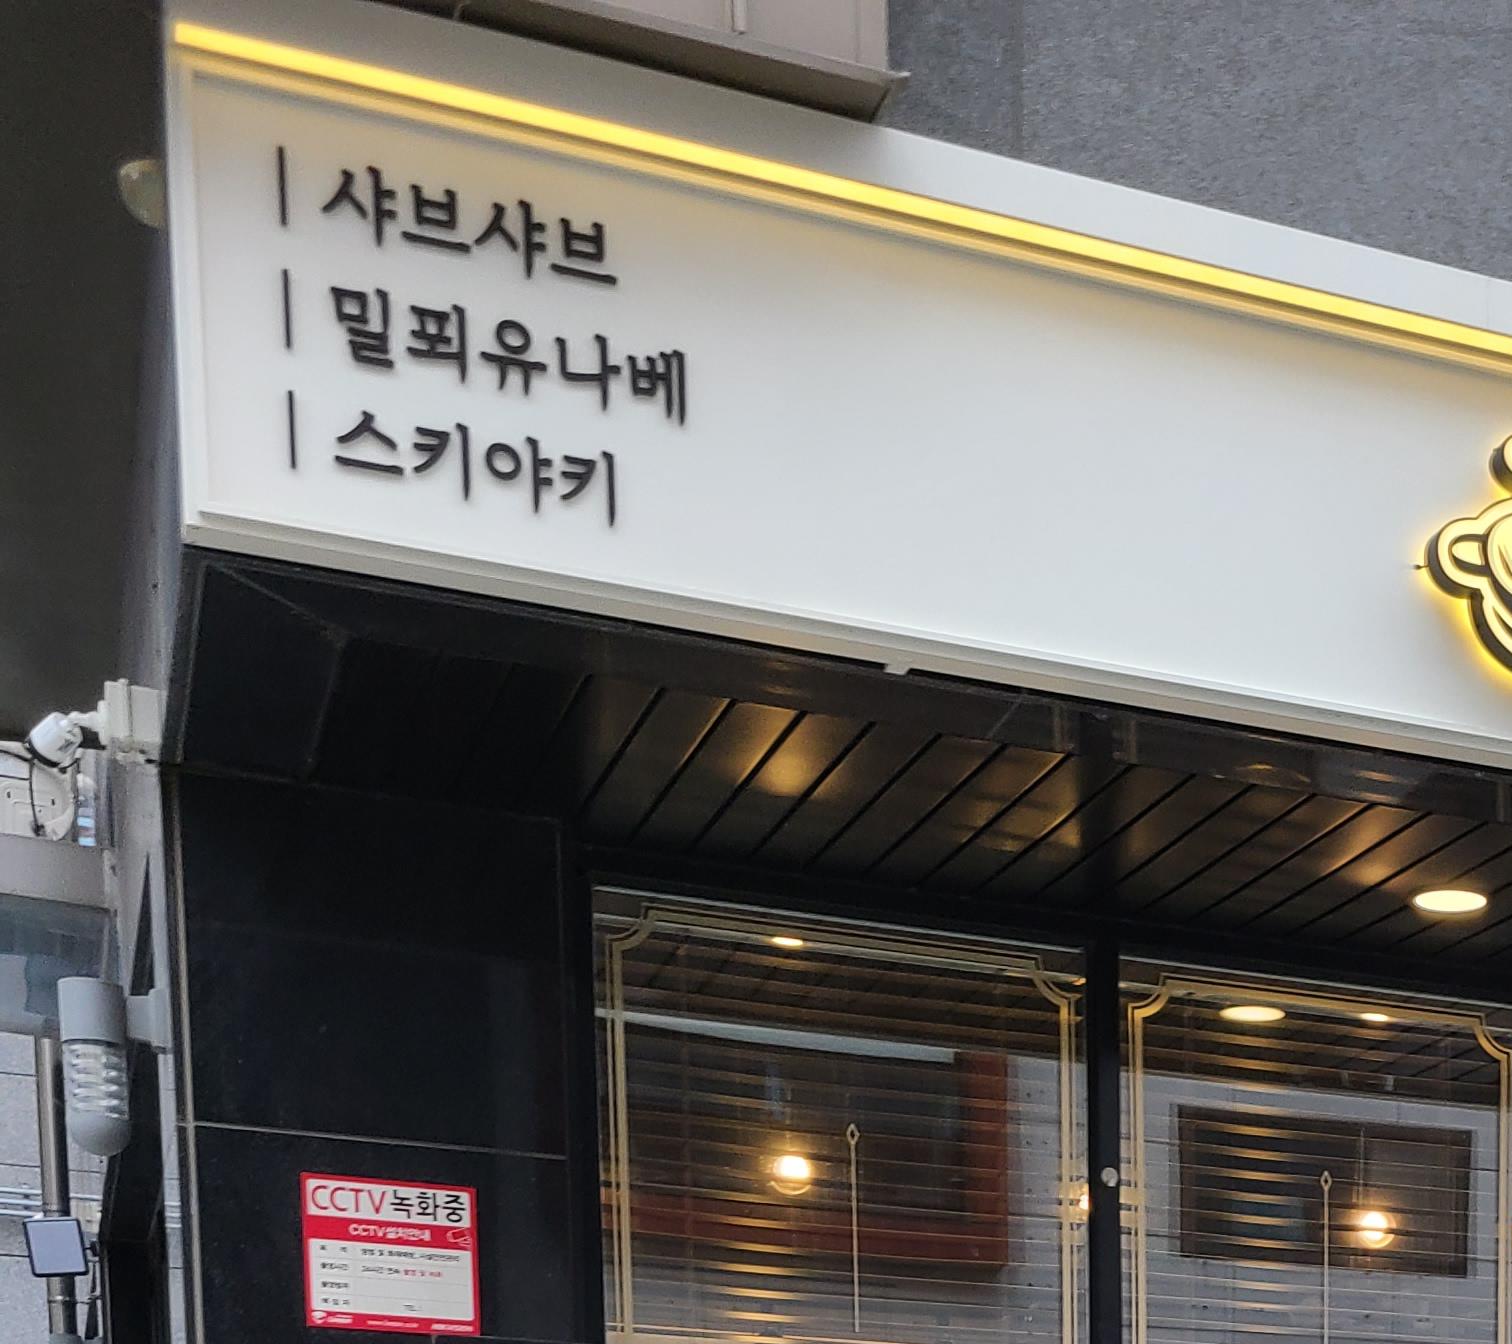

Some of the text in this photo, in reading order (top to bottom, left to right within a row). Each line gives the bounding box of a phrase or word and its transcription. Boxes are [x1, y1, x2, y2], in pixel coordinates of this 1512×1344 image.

[321, 163, 618, 287] 샤브샤브
[330, 285, 687, 427] 밀푀유나베
[334, 408, 619, 528] 스키야키
